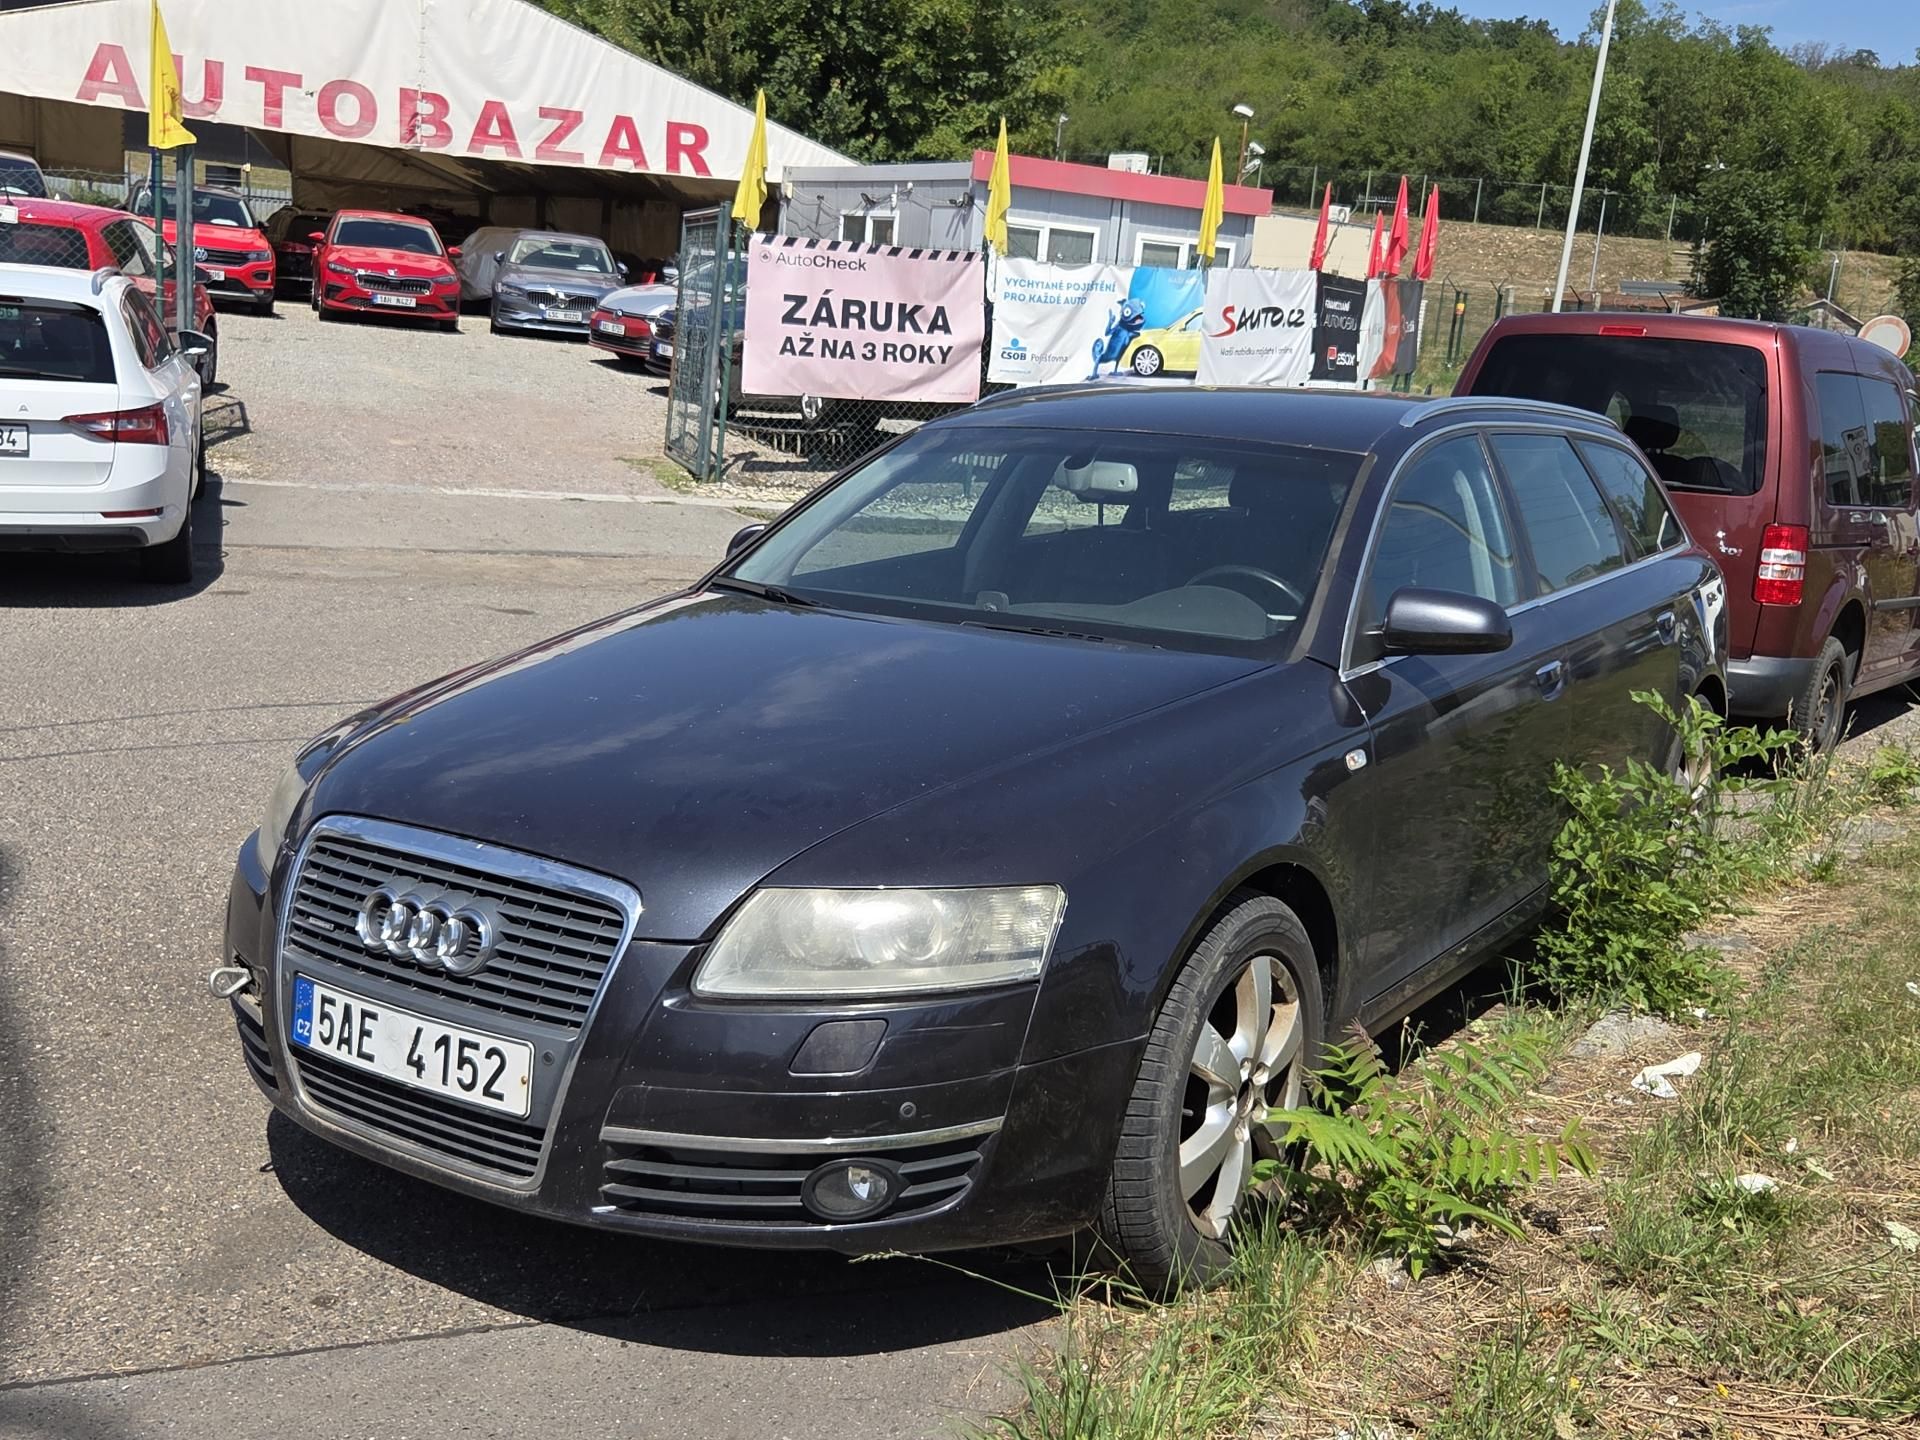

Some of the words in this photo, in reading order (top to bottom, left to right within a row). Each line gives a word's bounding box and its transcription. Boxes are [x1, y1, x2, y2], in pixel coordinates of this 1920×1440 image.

[76, 42, 713, 177] AUTOBAZAR
[776, 252, 867, 271] AutoCheck
[781, 289, 952, 335] ZÁRUKA
[1003, 291, 1026, 302] PRO
[1028, 292, 1062, 305] KAŽDÉ
[1063, 296, 1087, 305] AUTO
[779, 332, 814, 358] AŽ
[821, 339, 856, 361] NA
[862, 342, 877, 362] 3
[883, 343, 953, 365] ROKY
[297, 1018, 310, 1036] CZ
[318, 993, 378, 1063] 5AE
[406, 1026, 507, 1102] 4152
